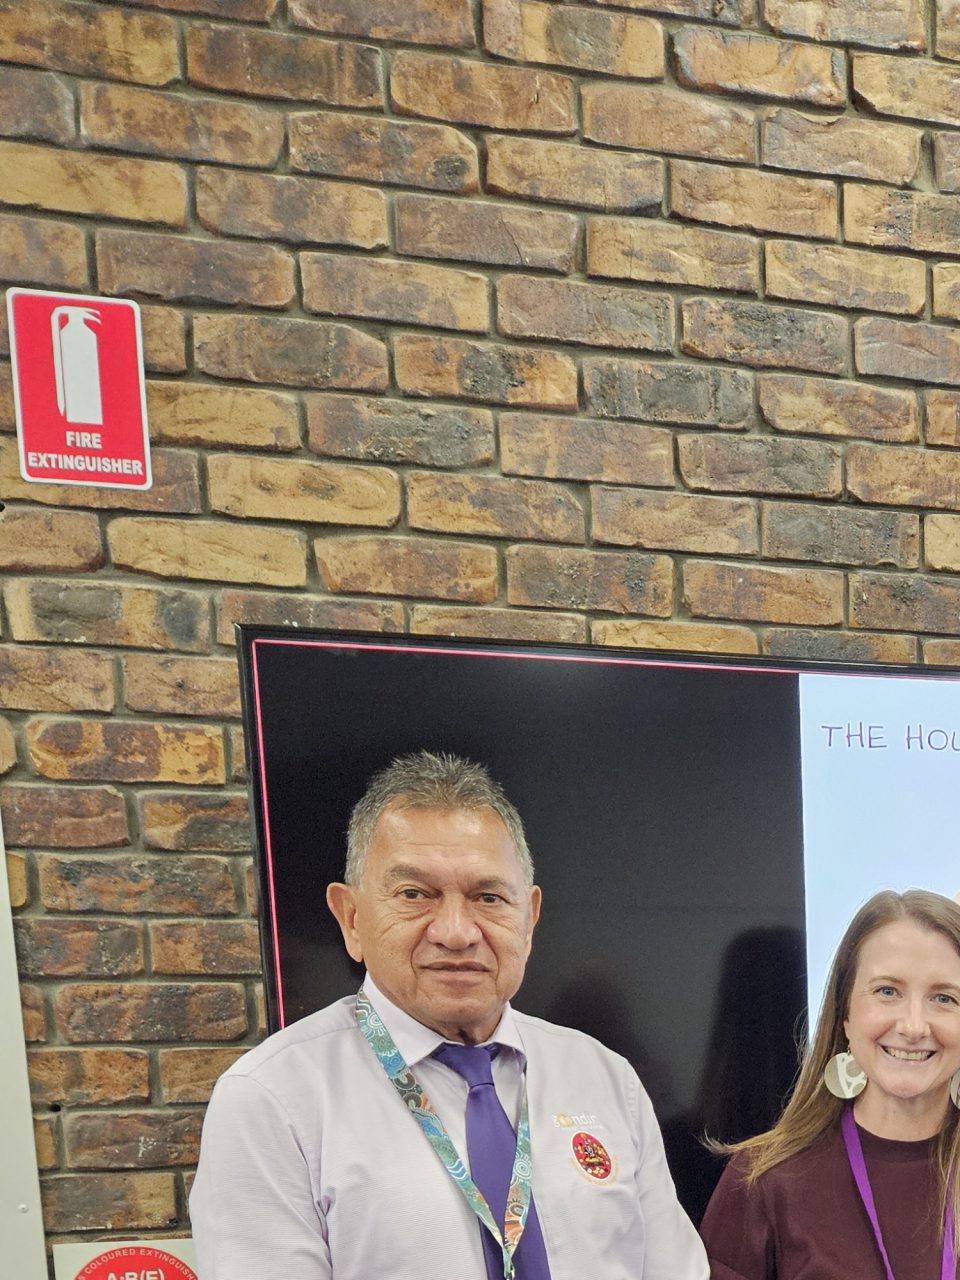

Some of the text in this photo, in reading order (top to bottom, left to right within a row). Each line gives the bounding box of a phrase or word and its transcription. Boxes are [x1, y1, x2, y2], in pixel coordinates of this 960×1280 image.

[66, 431, 102, 449] FIRE
[28, 452, 143, 475] EXTINGUISHER
[821, 721, 888, 749] THE
[84, 1249, 136, 1274] COLOURED
